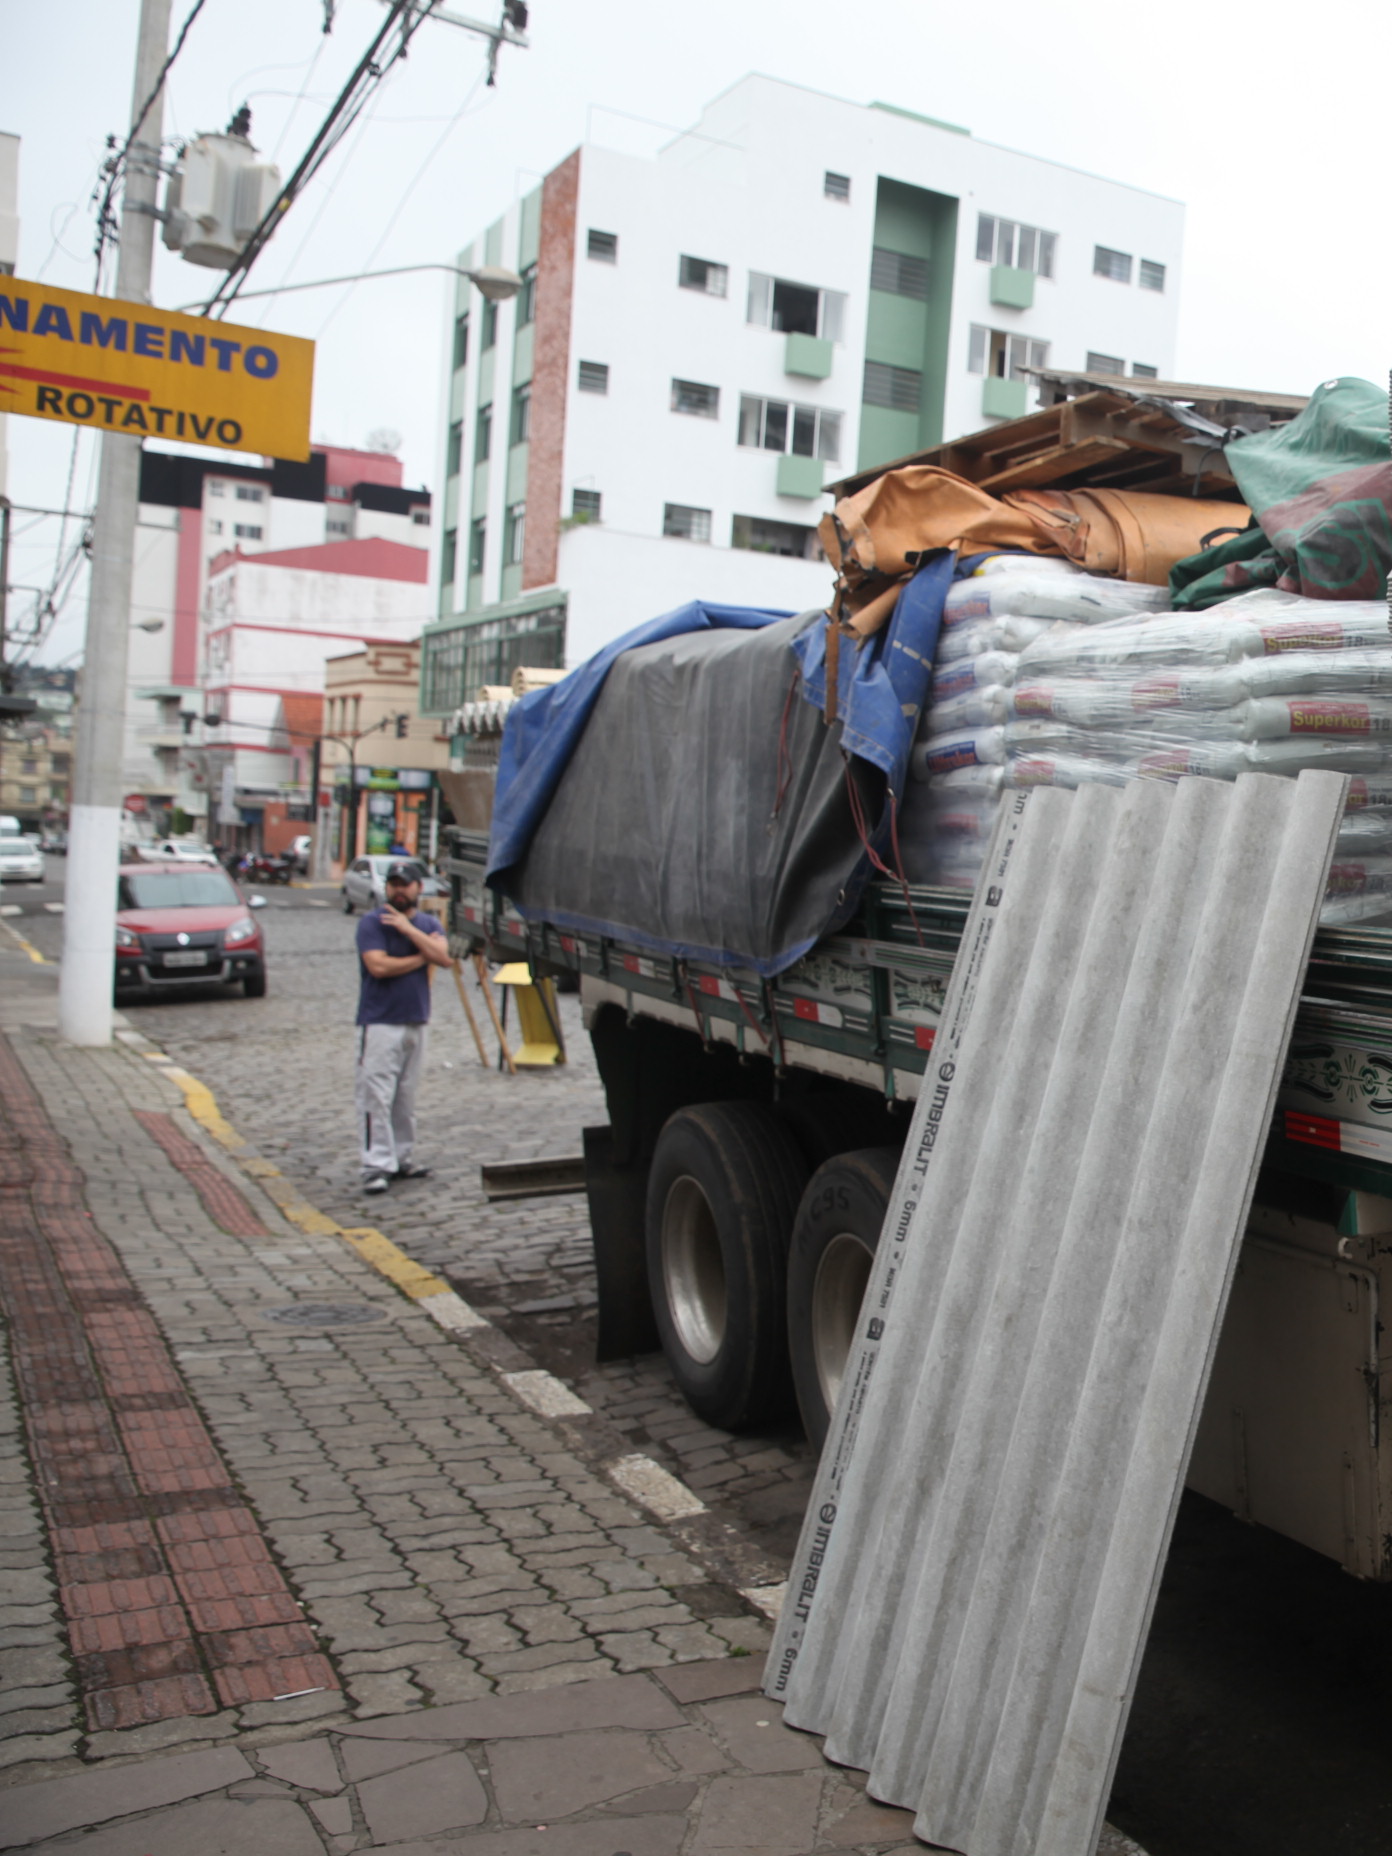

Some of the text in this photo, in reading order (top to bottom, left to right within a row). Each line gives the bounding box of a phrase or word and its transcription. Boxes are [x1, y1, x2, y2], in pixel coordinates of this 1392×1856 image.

[36, 386, 243, 445] ROTATIVO
[1293, 711, 1367, 729] Superkor
[894, 1199, 917, 1243] 6mm
[774, 1647, 798, 1692] 6mm
